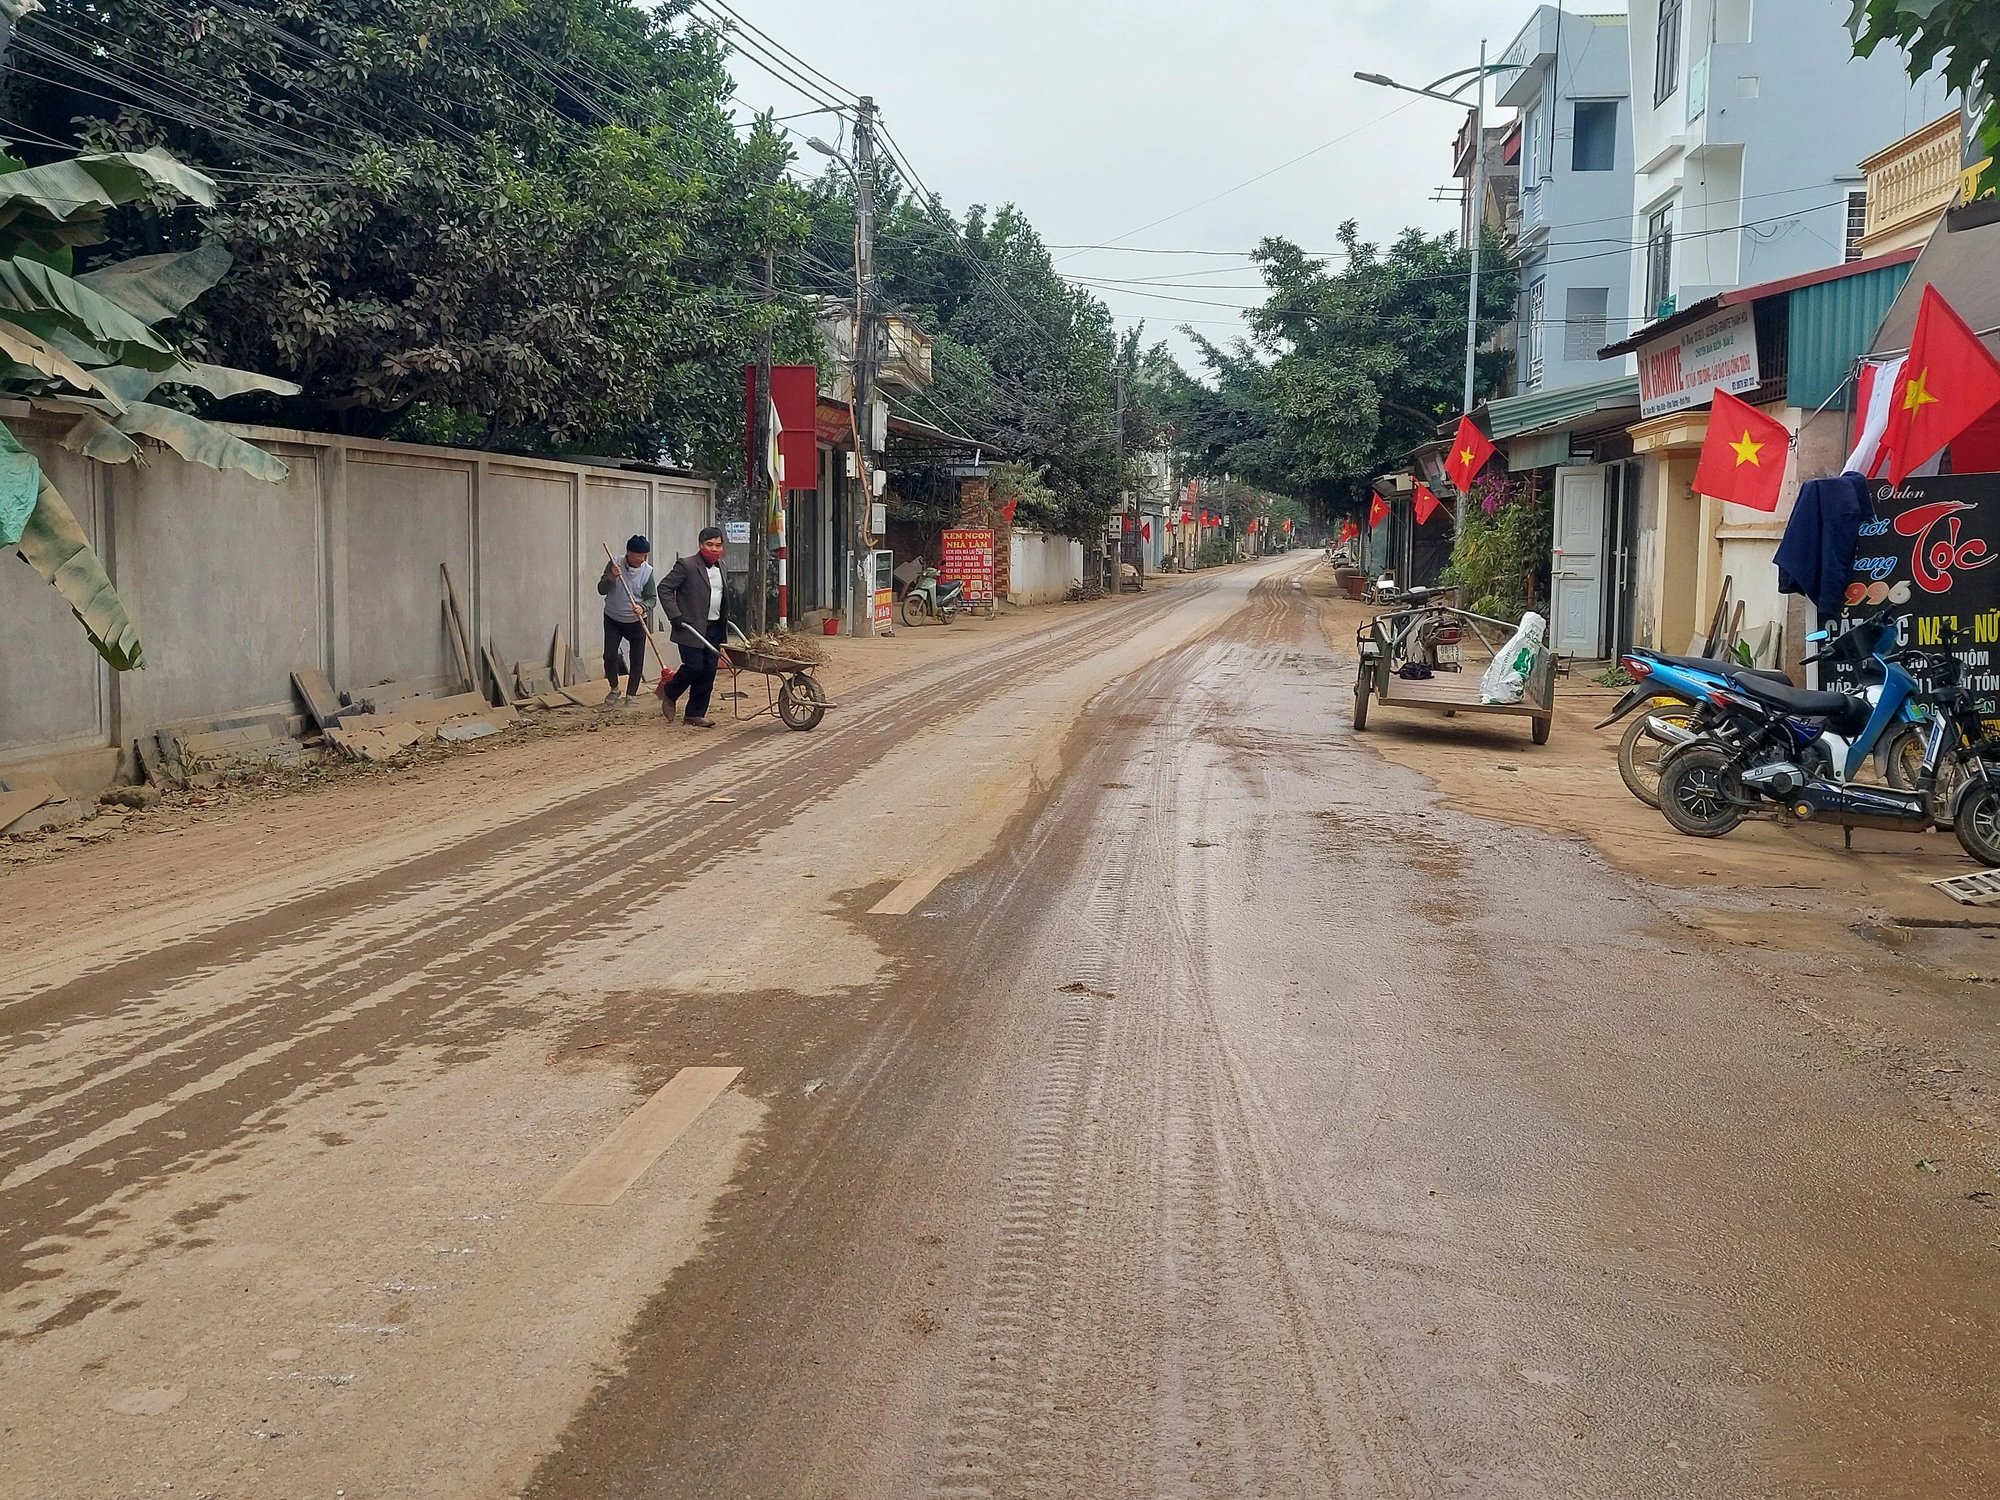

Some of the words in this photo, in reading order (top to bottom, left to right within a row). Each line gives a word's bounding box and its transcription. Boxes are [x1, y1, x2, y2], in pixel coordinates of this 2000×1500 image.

[1650, 345, 1684, 399] GRANITE
[1877, 485, 1926, 502] Salon
[943, 532, 963, 540] KEM
[965, 532, 991, 540] NGON
[946, 539, 967, 548] NHÀ
[969, 539, 988, 548] LÀM
[1894, 500, 1999, 594] Tóc
